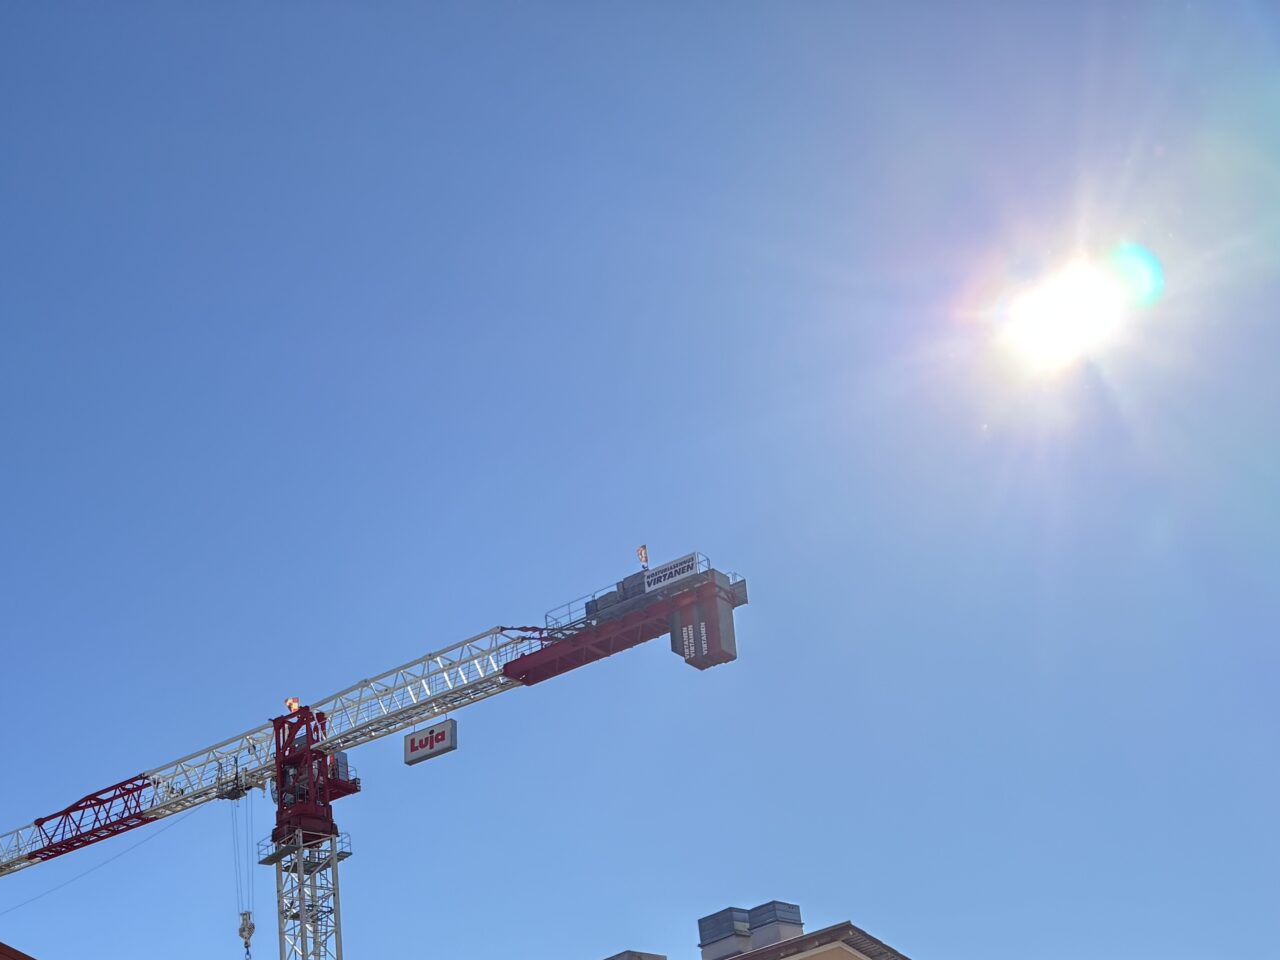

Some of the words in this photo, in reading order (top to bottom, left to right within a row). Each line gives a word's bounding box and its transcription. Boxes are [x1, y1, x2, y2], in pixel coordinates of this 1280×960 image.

[646, 563, 695, 588] VIRTANEN
[682, 626, 690, 660] VIRTANEN
[700, 622, 708, 656] VIRTANEN
[410, 729, 446, 753] Luja
